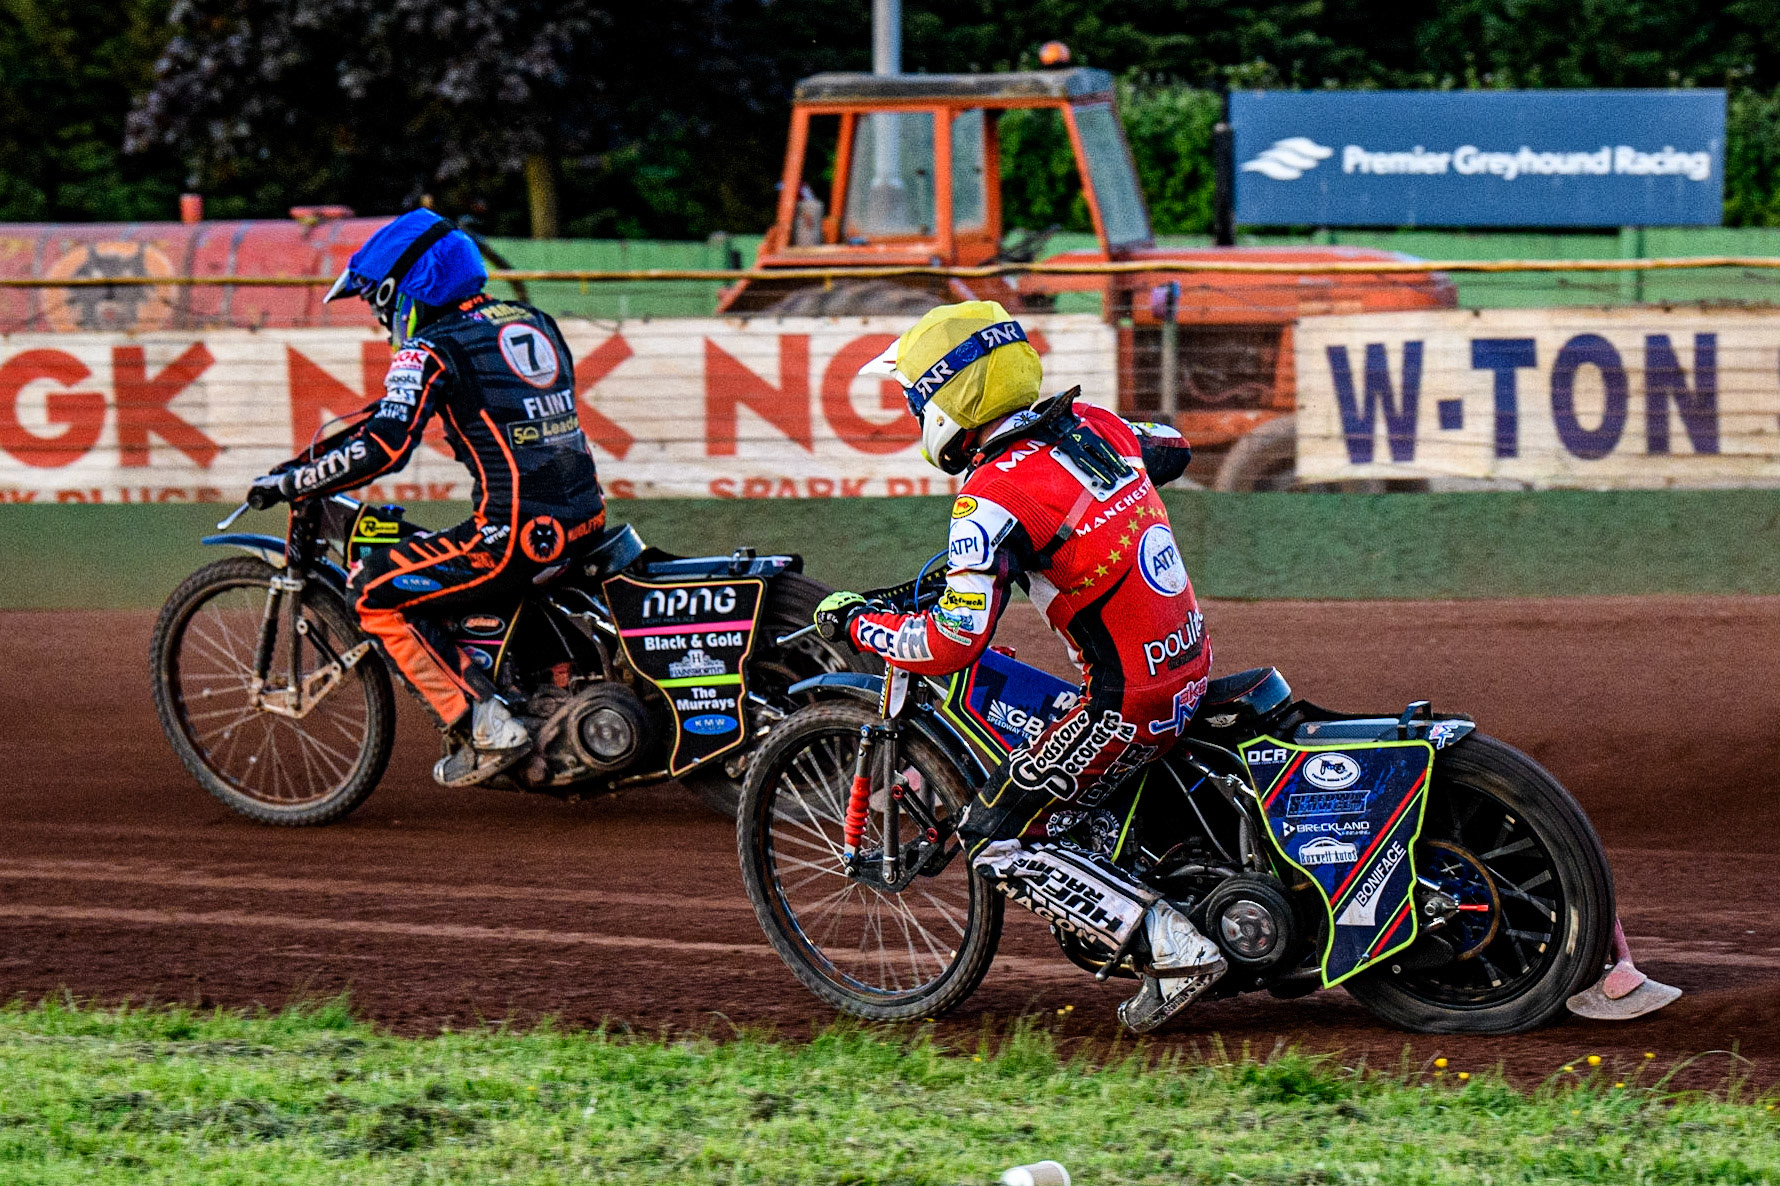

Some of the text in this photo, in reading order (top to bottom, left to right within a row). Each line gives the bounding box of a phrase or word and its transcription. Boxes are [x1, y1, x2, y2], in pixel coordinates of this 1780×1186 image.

[1342, 144, 1712, 181] Premier Greyhound Racing
[510, 332, 541, 372] 7
[523, 389, 574, 420] FLINT
[950, 536, 979, 558] ATPI
[643, 631, 744, 651] Black & Gold
[676, 697, 736, 711] Murrays
[690, 686, 717, 700] The
[1007, 709, 1045, 736] GB
[1296, 820, 1370, 836] BRECKLAND
[1355, 841, 1404, 905] BONIFACE
